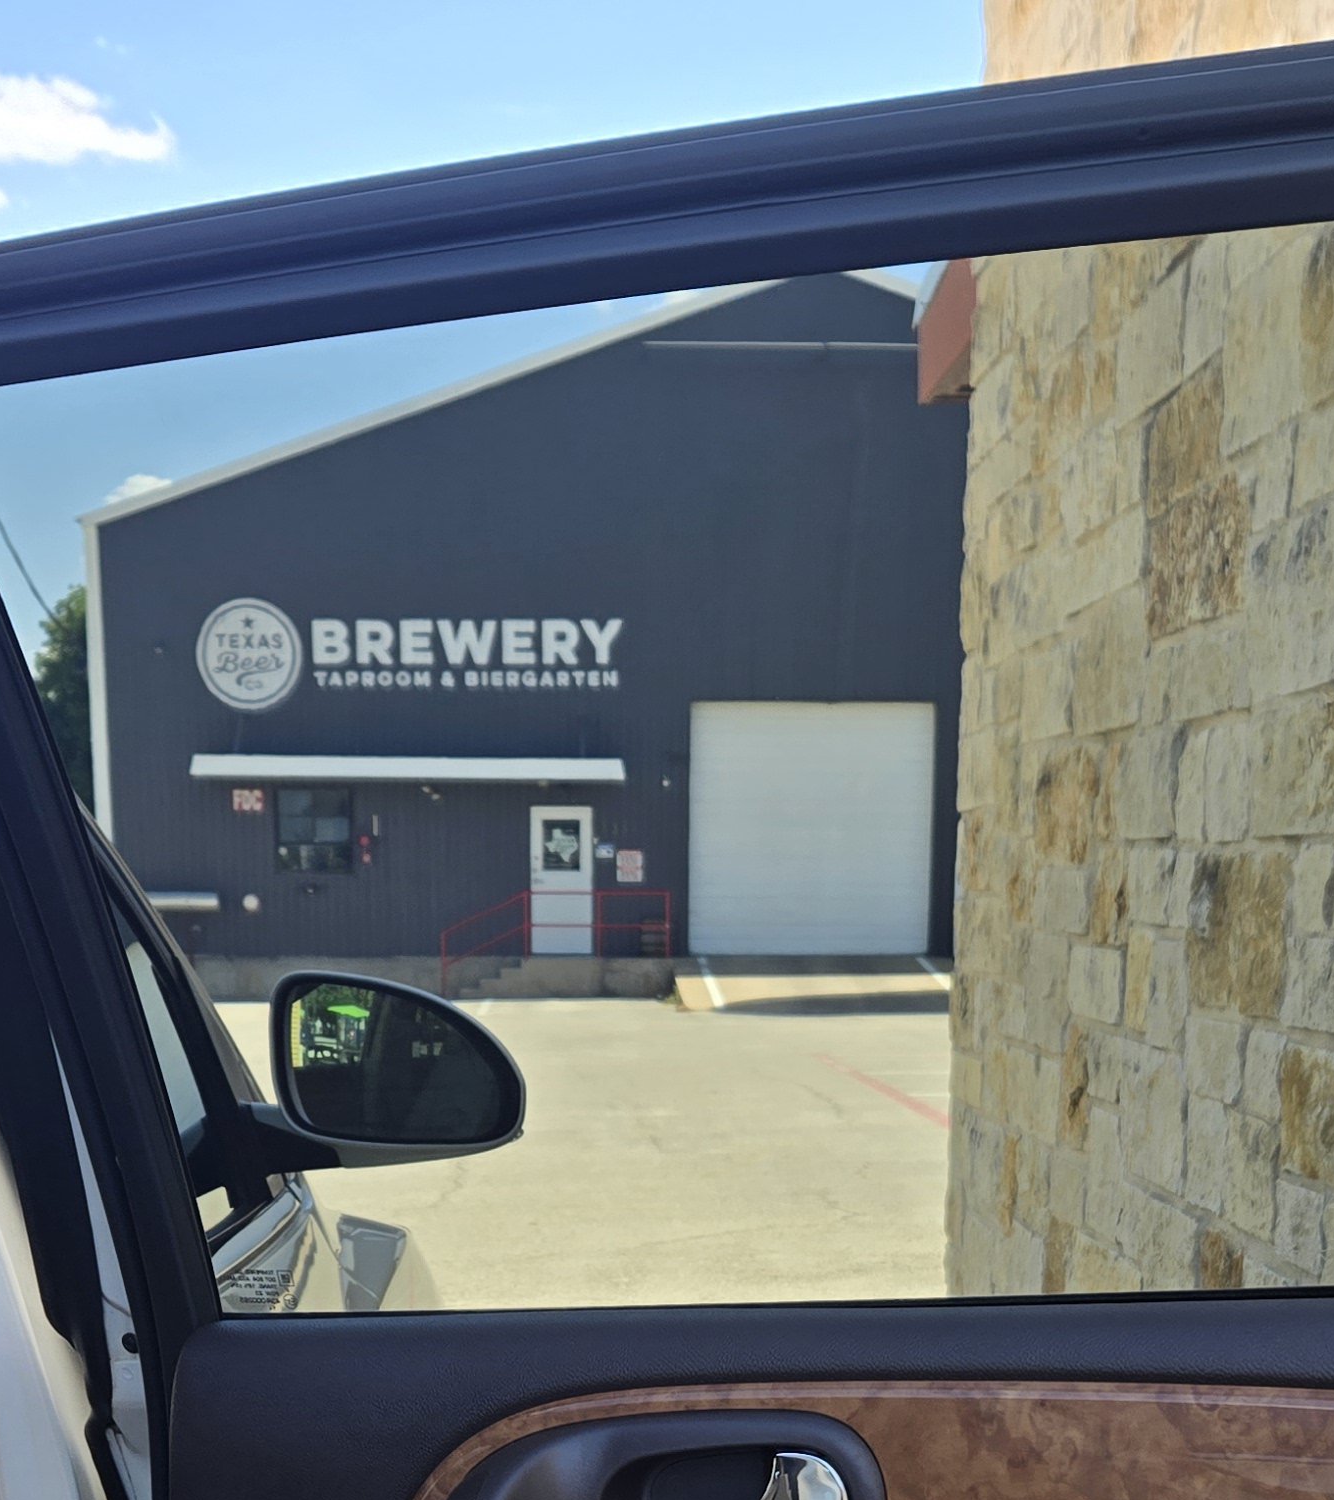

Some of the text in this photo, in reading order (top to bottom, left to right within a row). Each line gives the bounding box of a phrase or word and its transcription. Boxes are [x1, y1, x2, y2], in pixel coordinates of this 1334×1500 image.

[215, 632, 284, 649] TEXAS
[310, 618, 624, 666] BREWERY
[213, 651, 285, 680] Beer
[313, 670, 619, 688] TAPROOM & BIERGARTEN
[232, 788, 264, 812] FDC
